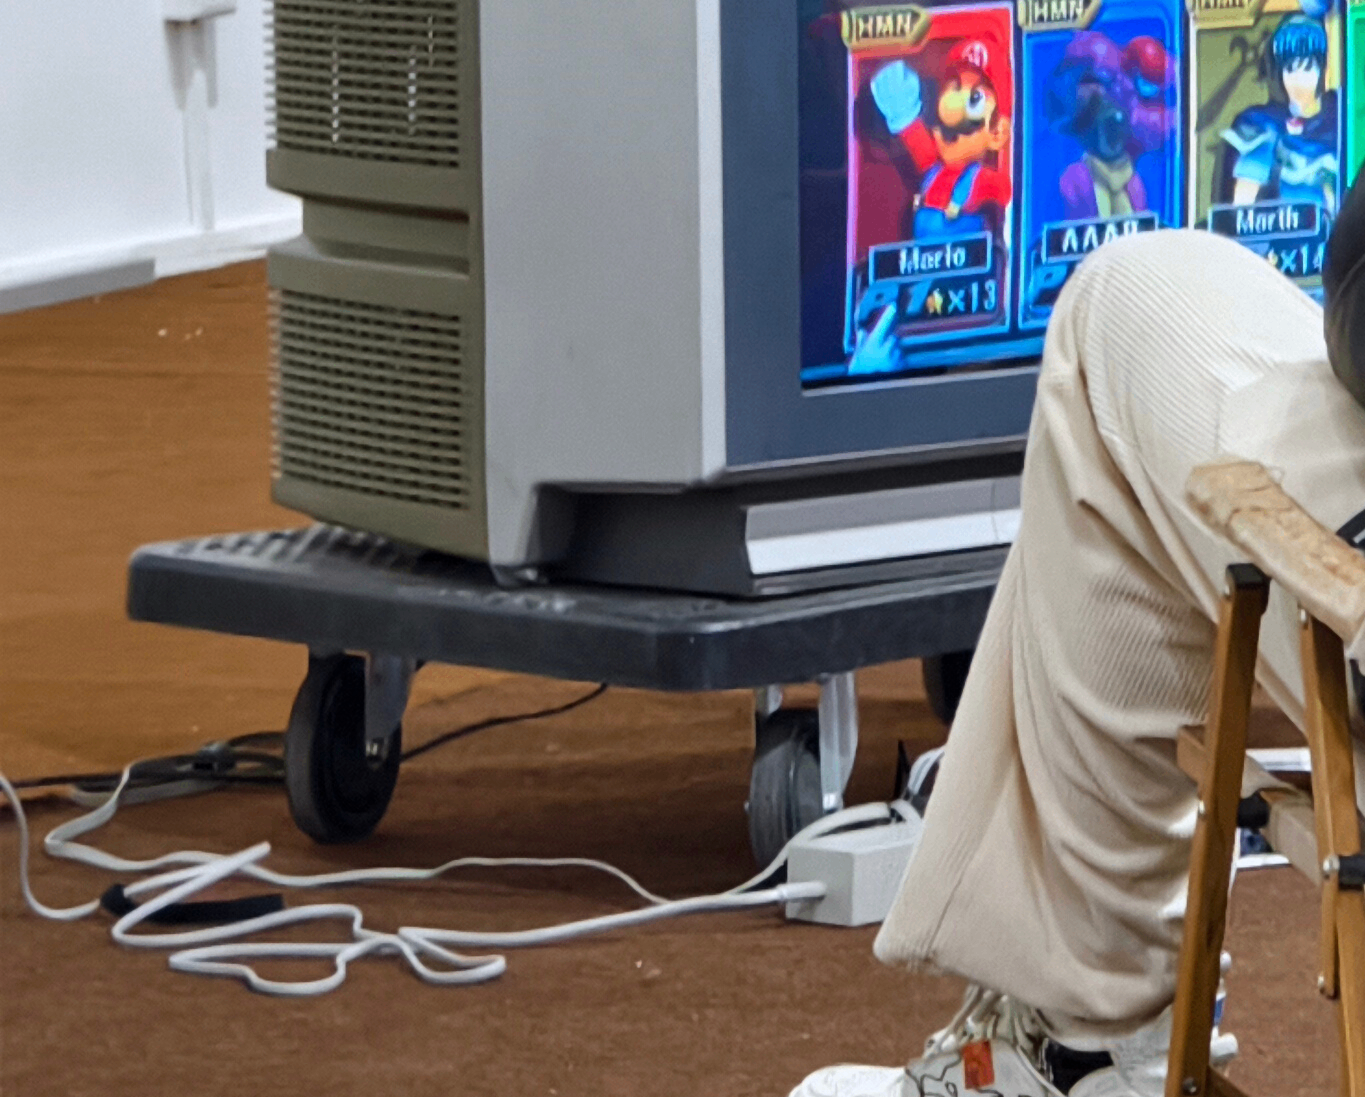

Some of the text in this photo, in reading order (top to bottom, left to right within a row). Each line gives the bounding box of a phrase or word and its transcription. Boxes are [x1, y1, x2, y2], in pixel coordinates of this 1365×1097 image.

[858, 10, 912, 40] HMN
[1236, 205, 1299, 234] Marth
[899, 243, 966, 275] Mario
